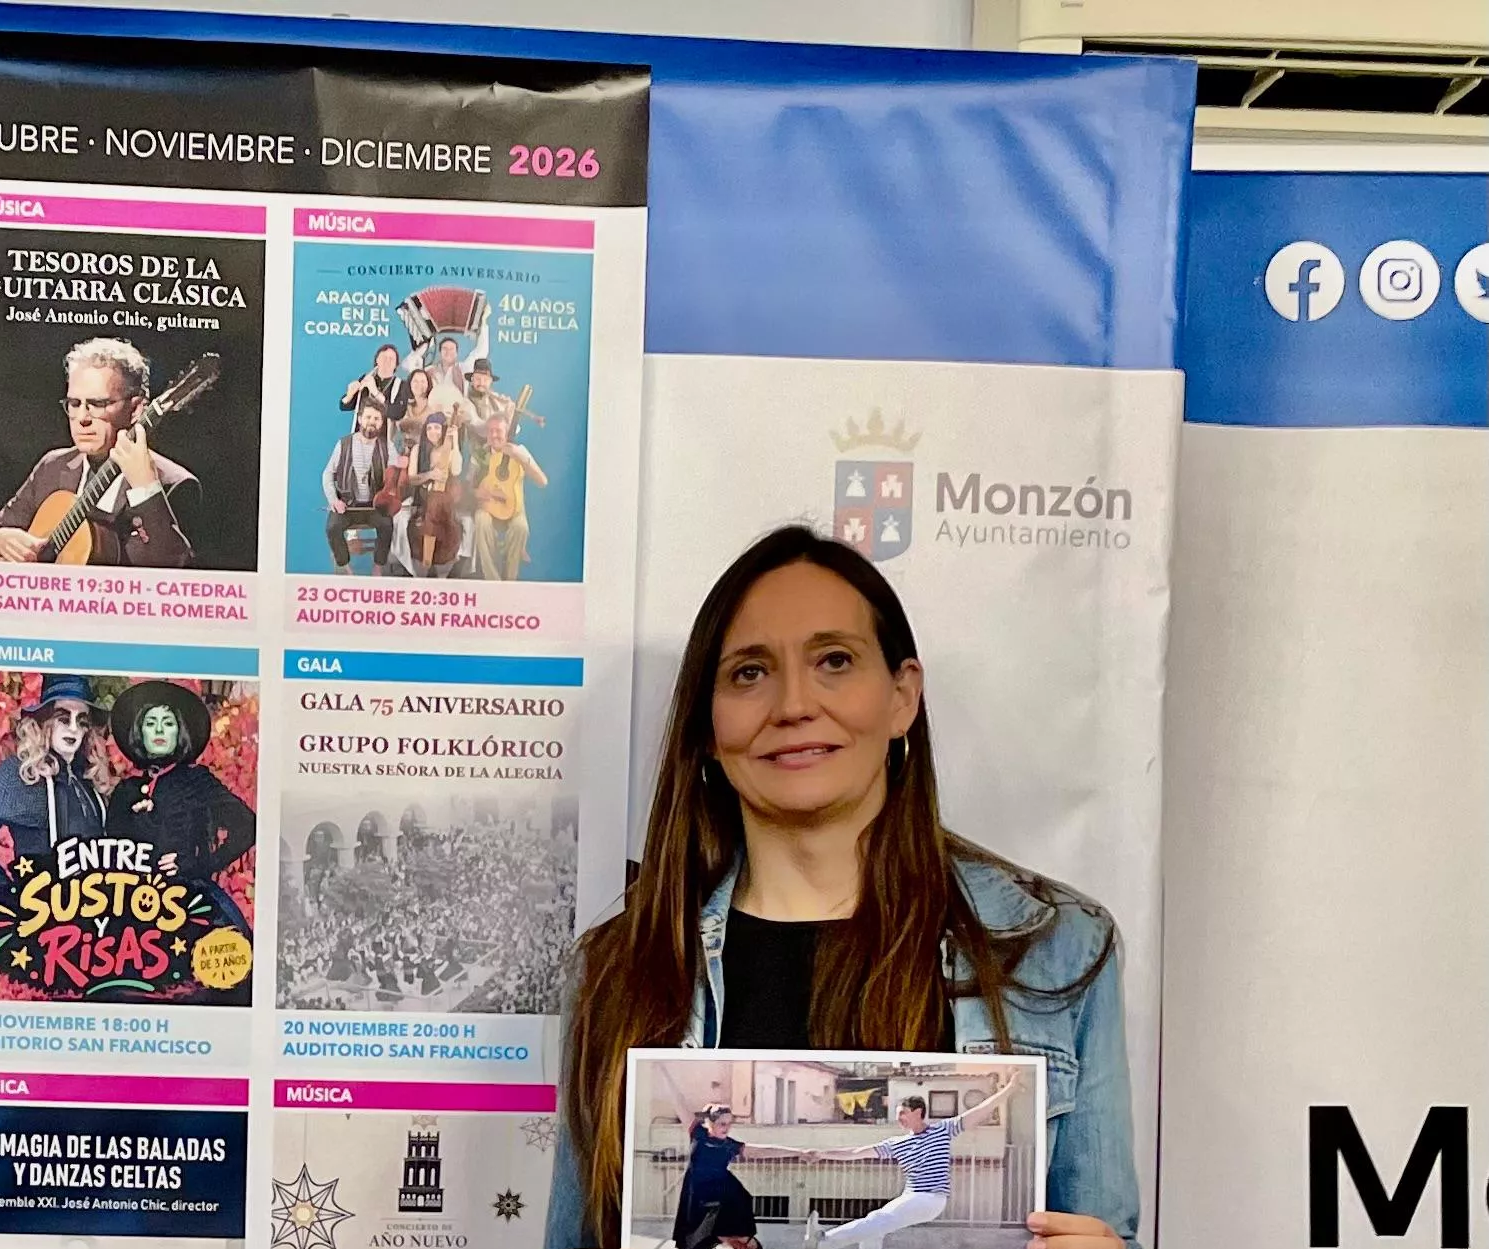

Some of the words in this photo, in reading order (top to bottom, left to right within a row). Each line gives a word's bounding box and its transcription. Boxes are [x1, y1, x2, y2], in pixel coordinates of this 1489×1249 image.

[105, 130, 294, 166] NOVIEMBRE
[321, 138, 491, 174] DICIEMBRE
[509, 145, 601, 179] 2026
[7, 249, 133, 278] TESOROS
[141, 254, 180, 279] DE
[184, 255, 220, 281] LA
[347, 264, 434, 278] CONCIERTO
[440, 266, 541, 285] ANIVERSARIO
[133, 277, 246, 309] CLÁSICA
[316, 288, 390, 306] ARAGÓN
[498, 294, 523, 314] 40
[526, 296, 575, 315] AÑOS
[6, 306, 41, 325] José
[45, 308, 108, 327] Antonio
[112, 310, 153, 330] Chic,
[157, 312, 220, 333] guitarra
[304, 316, 390, 338] CORAZÓN
[342, 307, 367, 322] EN
[370, 308, 389, 323] EL
[498, 312, 516, 328] de
[521, 314, 579, 331] BIELLA
[497, 329, 538, 345] NUEI
[936, 472, 1132, 521] Monzón
[935, 519, 1131, 550] Ayuntamiento
[298, 657, 342, 674] GALA
[300, 692, 364, 712] GALA
[370, 697, 393, 716] 75
[398, 697, 565, 718] ANIVERSARIO
[299, 734, 390, 757] GRUPO
[397, 732, 564, 759] FOLKLÓRICO
[298, 764, 371, 778] NUESTRA
[375, 762, 438, 779] SEÑORA
[444, 766, 464, 779] DE
[469, 766, 489, 779] LA
[494, 765, 563, 780] ALEGRÍA
[57, 837, 153, 879] ENTRE
[17, 871, 188, 937] SUSTOS
[94, 916, 109, 937] Y
[0, 1133, 62, 1158] MAGIA
[66, 1135, 92, 1158] DE
[95, 1135, 132, 1160] LAS
[136, 1136, 226, 1162] BALADAS
[14, 1162, 26, 1186] Y
[28, 1162, 106, 1188] DANZAS
[110, 1164, 182, 1189] CELTAS
[369, 1229, 406, 1248] AÑO
[410, 1232, 468, 1248] NUEVO
